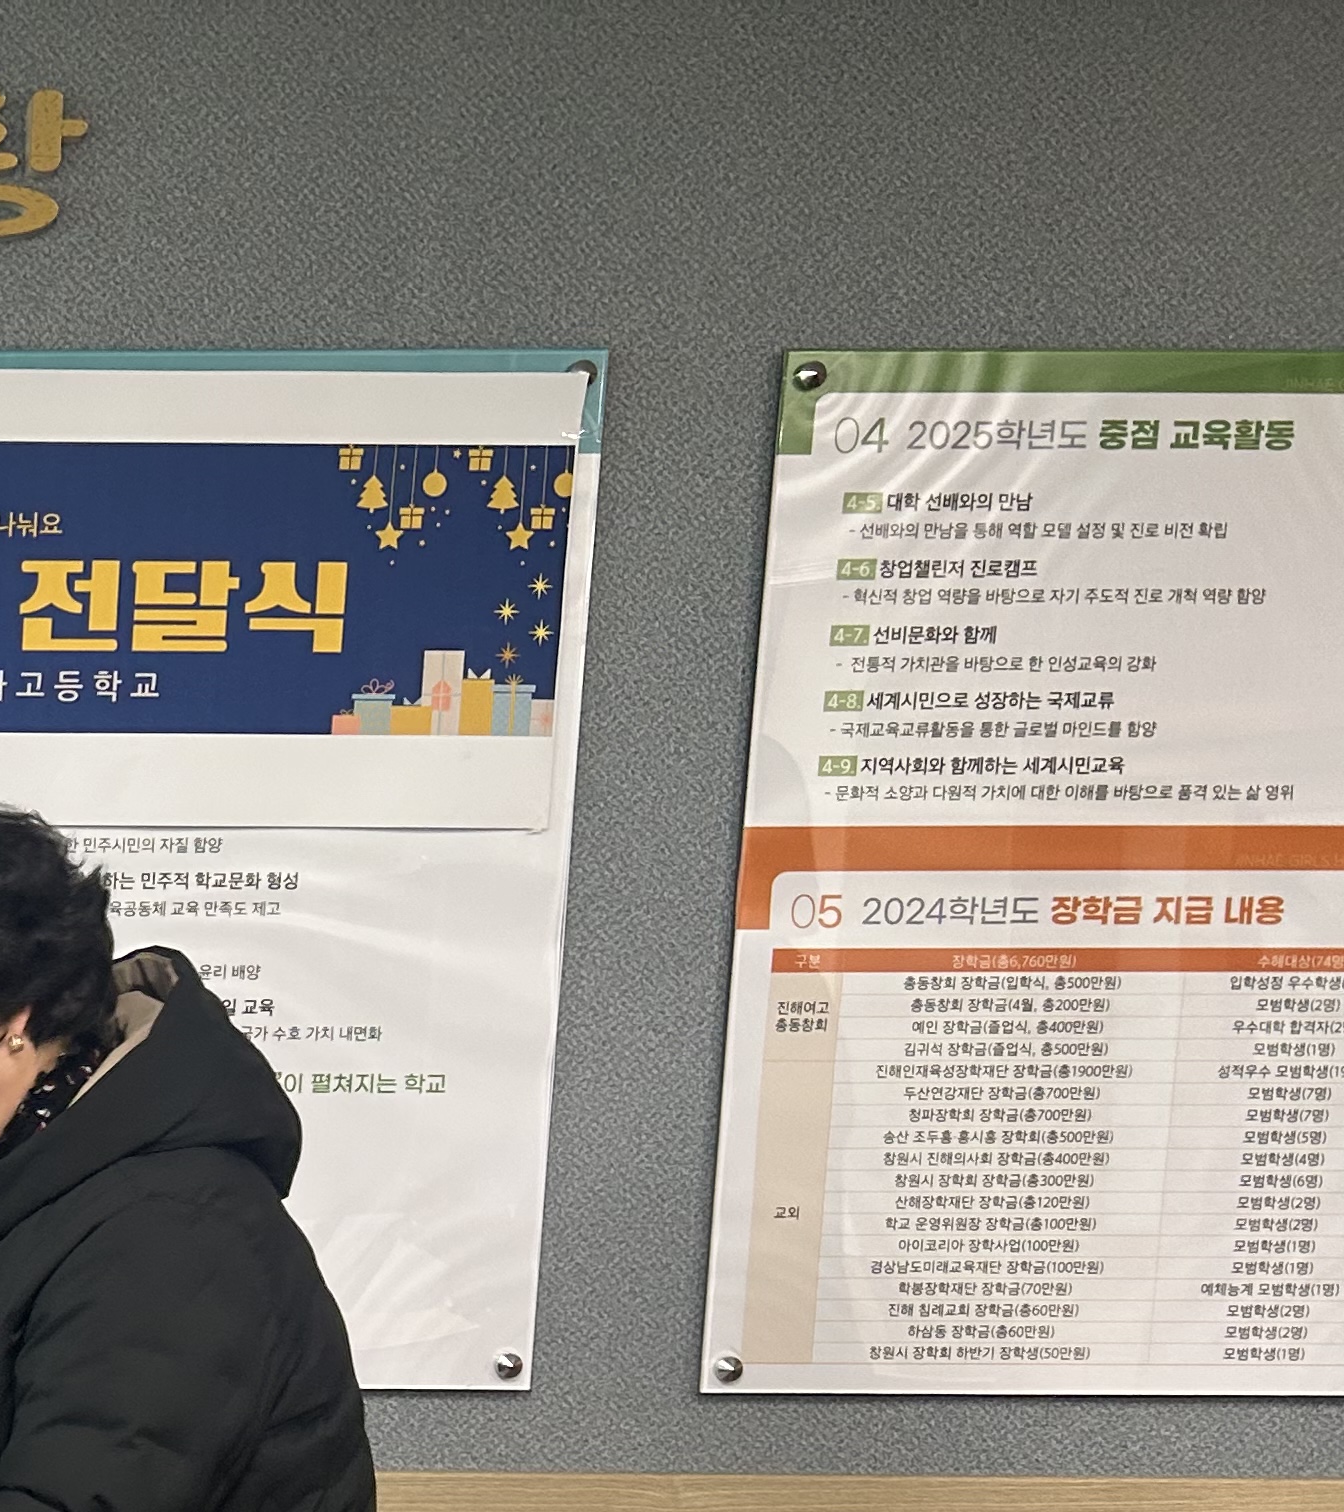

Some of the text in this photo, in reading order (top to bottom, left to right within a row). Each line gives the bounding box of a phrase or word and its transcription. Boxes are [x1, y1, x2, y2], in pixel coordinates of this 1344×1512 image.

[835, 417, 1294, 454] 04 2025학년도 중점 교육활동
[887, 493, 920, 511] 대학
[926, 493, 993, 511] 선배와의
[999, 493, 1033, 511] 만남
[840, 560, 1037, 578] 4-6. 창업챌린저 진로캠프
[20, 560, 347, 652] 전달식
[833, 626, 997, 644] 4-7. 선비문화와 함께
[827, 691, 1114, 710] 4-8. 세계시민으로 성장하는 국제교류
[822, 756, 1124, 775] 4-9. 지역사회와 함께하는 세계시민교육
[1031, 785, 1060, 800] 대한
[84, 837, 223, 853] 민주시민의 자질 함양
[141, 872, 298, 890] 민주적 학교문화 형성
[792, 894, 1284, 928] 05 2024학년도 장학금 지급 내용
[795, 954, 820, 969] 구분
[778, 1001, 829, 1015] 진해여고
[312, 1074, 445, 1094] 펼쳐지는 학교
